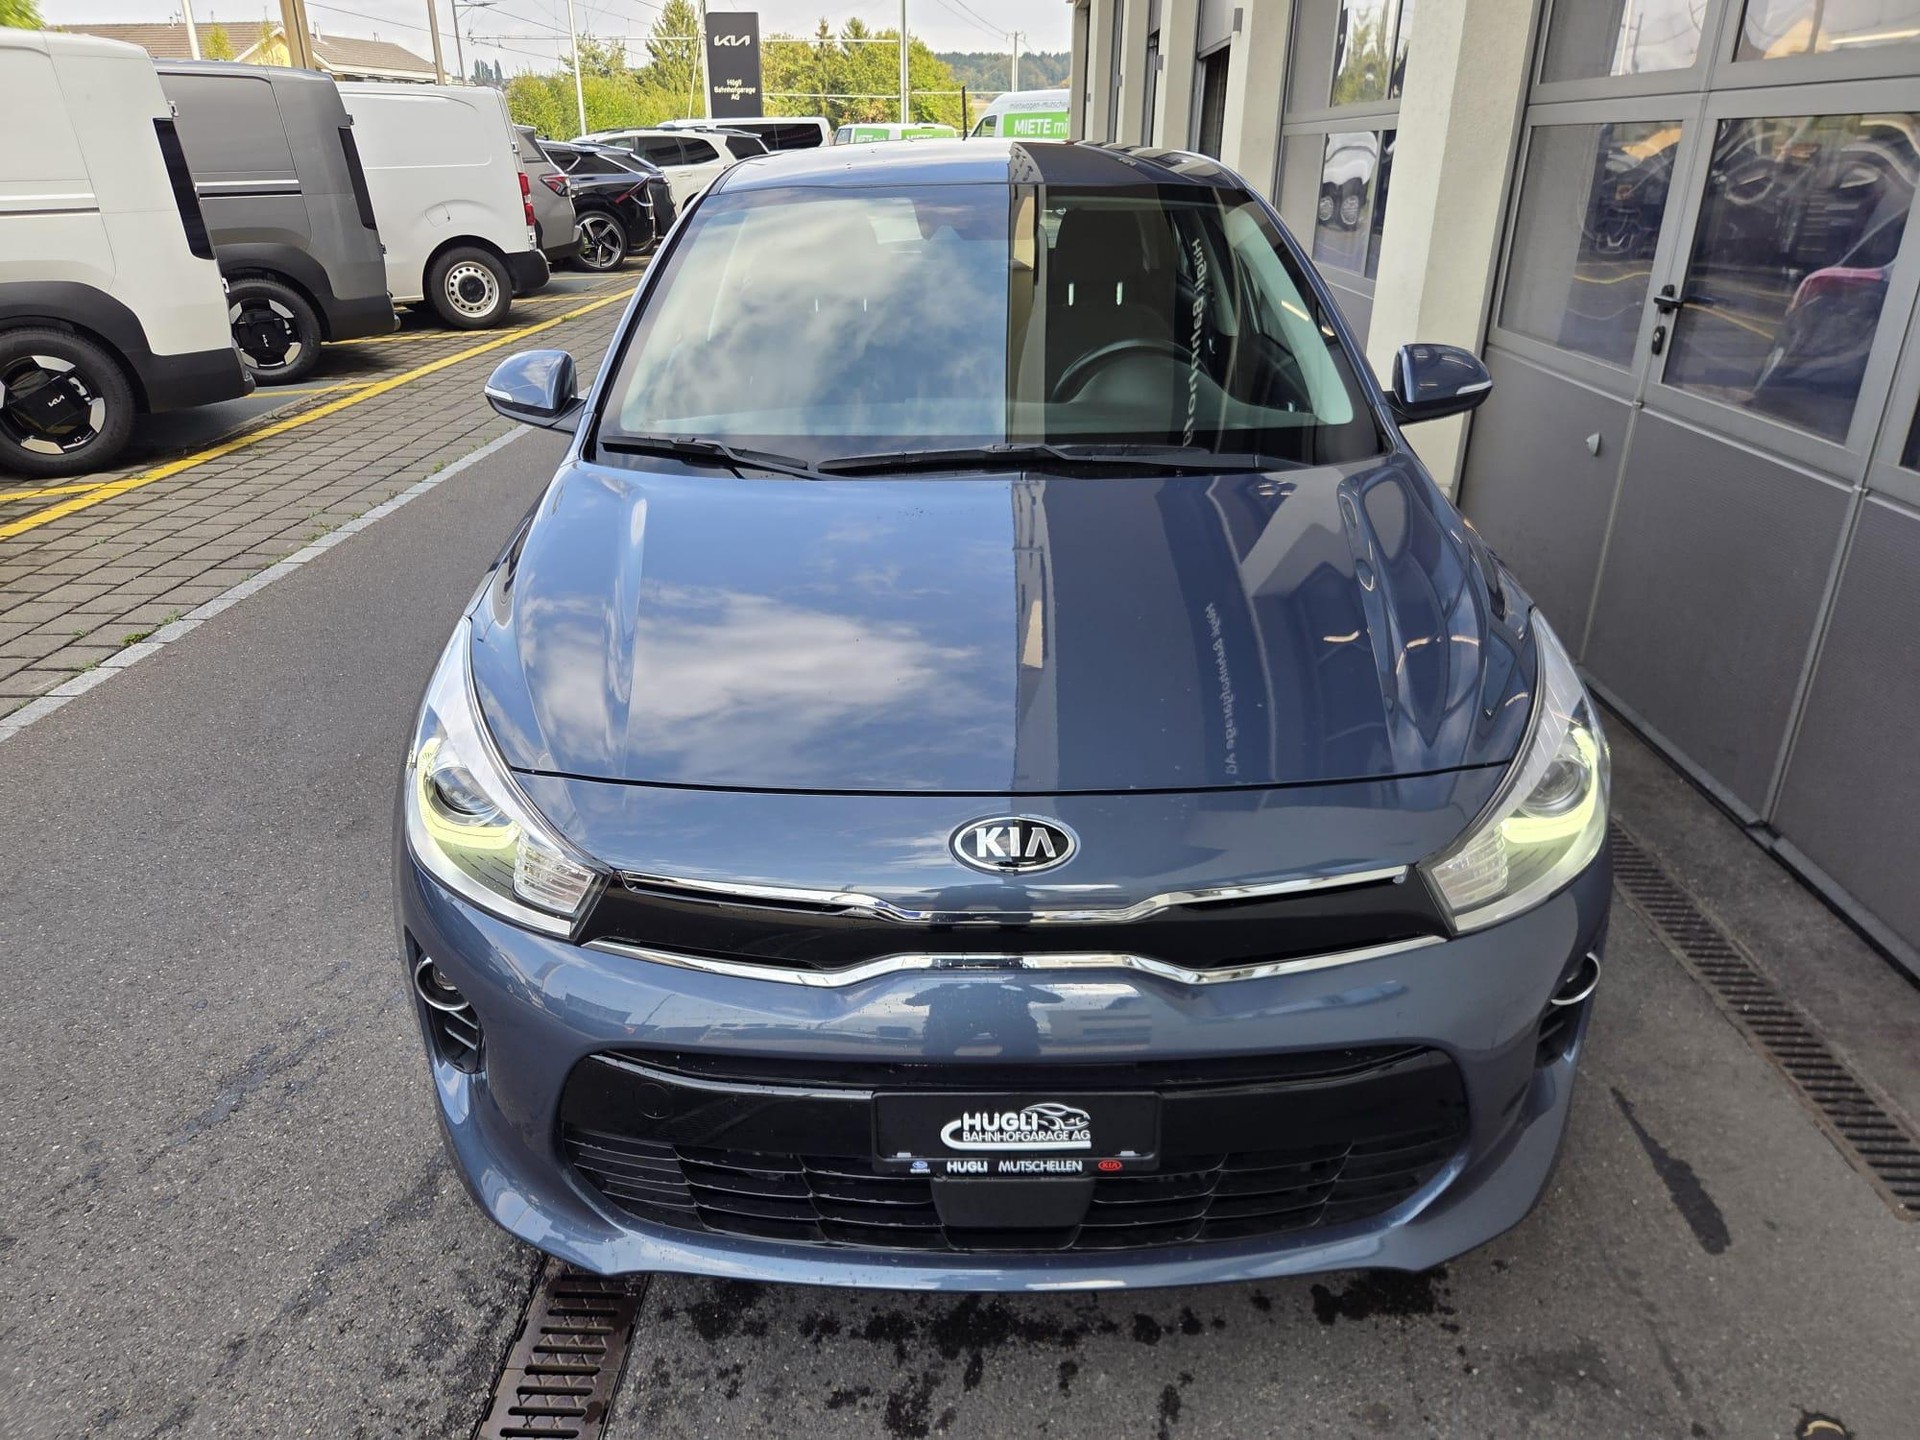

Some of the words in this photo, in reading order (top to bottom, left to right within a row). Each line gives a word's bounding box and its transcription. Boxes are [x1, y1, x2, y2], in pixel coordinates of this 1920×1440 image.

[1014, 119, 1051, 135] MIETE
[974, 826, 1057, 858] KIA
[962, 1131, 1069, 1142] BAHNHOFGARAGE
[1071, 1130, 1091, 1141] AG
[998, 1160, 1083, 1173] MUTSCHELLEN
